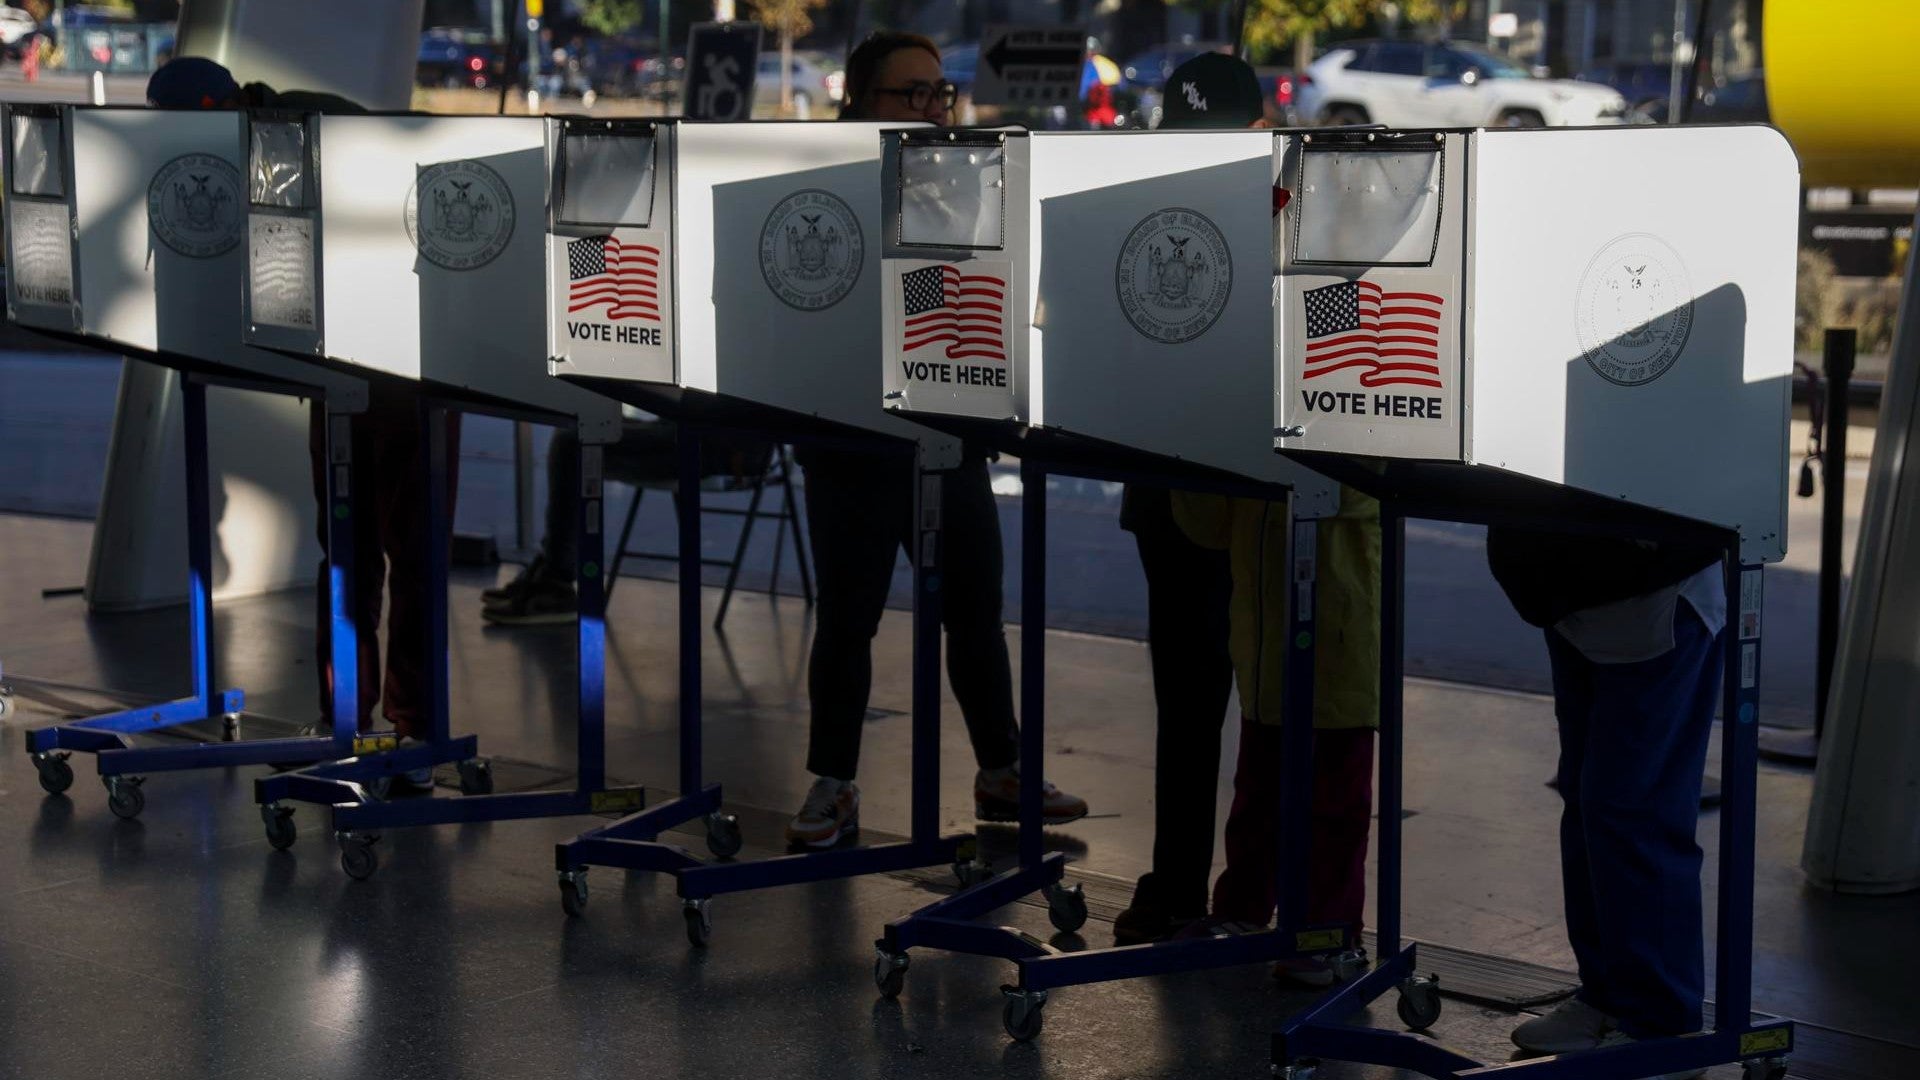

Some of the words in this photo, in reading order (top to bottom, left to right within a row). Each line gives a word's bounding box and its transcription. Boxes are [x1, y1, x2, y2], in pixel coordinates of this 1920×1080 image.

[567, 321, 611, 342] VOTE
[616, 325, 662, 346] HERE
[902, 360, 951, 383] VOTE
[956, 365, 1007, 387] HERE
[1599, 358, 1627, 379] CITY
[1628, 367, 1646, 380] OF
[1648, 347, 1674, 374] NEW
[1302, 390, 1366, 415] VOTE
[1374, 394, 1442, 419] HERE
